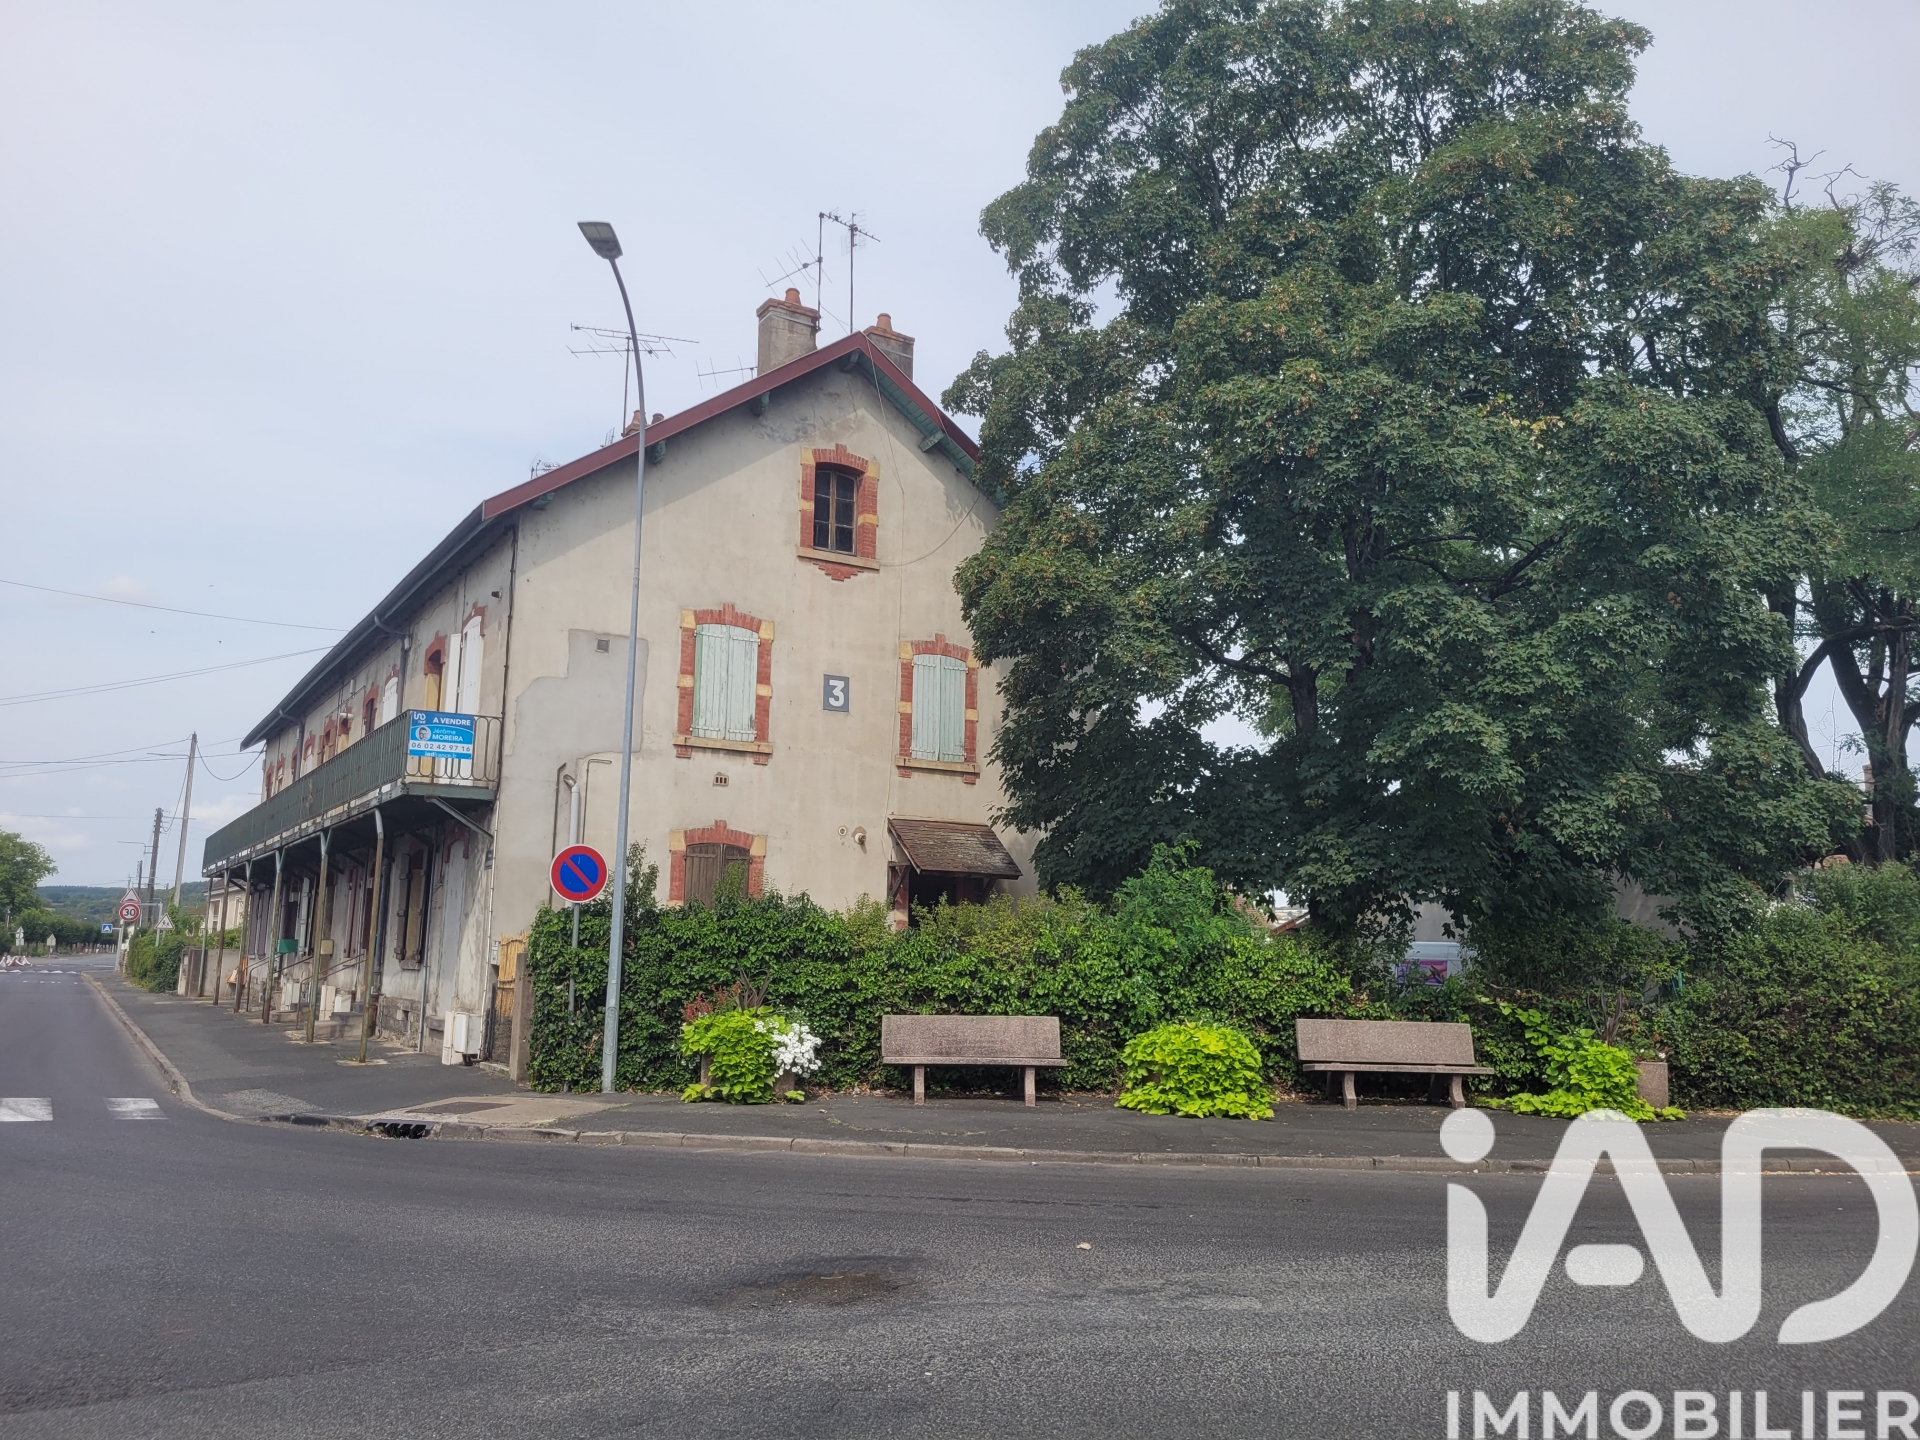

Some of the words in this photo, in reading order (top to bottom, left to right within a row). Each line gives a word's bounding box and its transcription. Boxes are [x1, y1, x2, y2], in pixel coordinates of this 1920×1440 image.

[828, 679, 845, 707] 3
[432, 734, 463, 742] MOREIRA
[124, 908, 136, 917] 30
